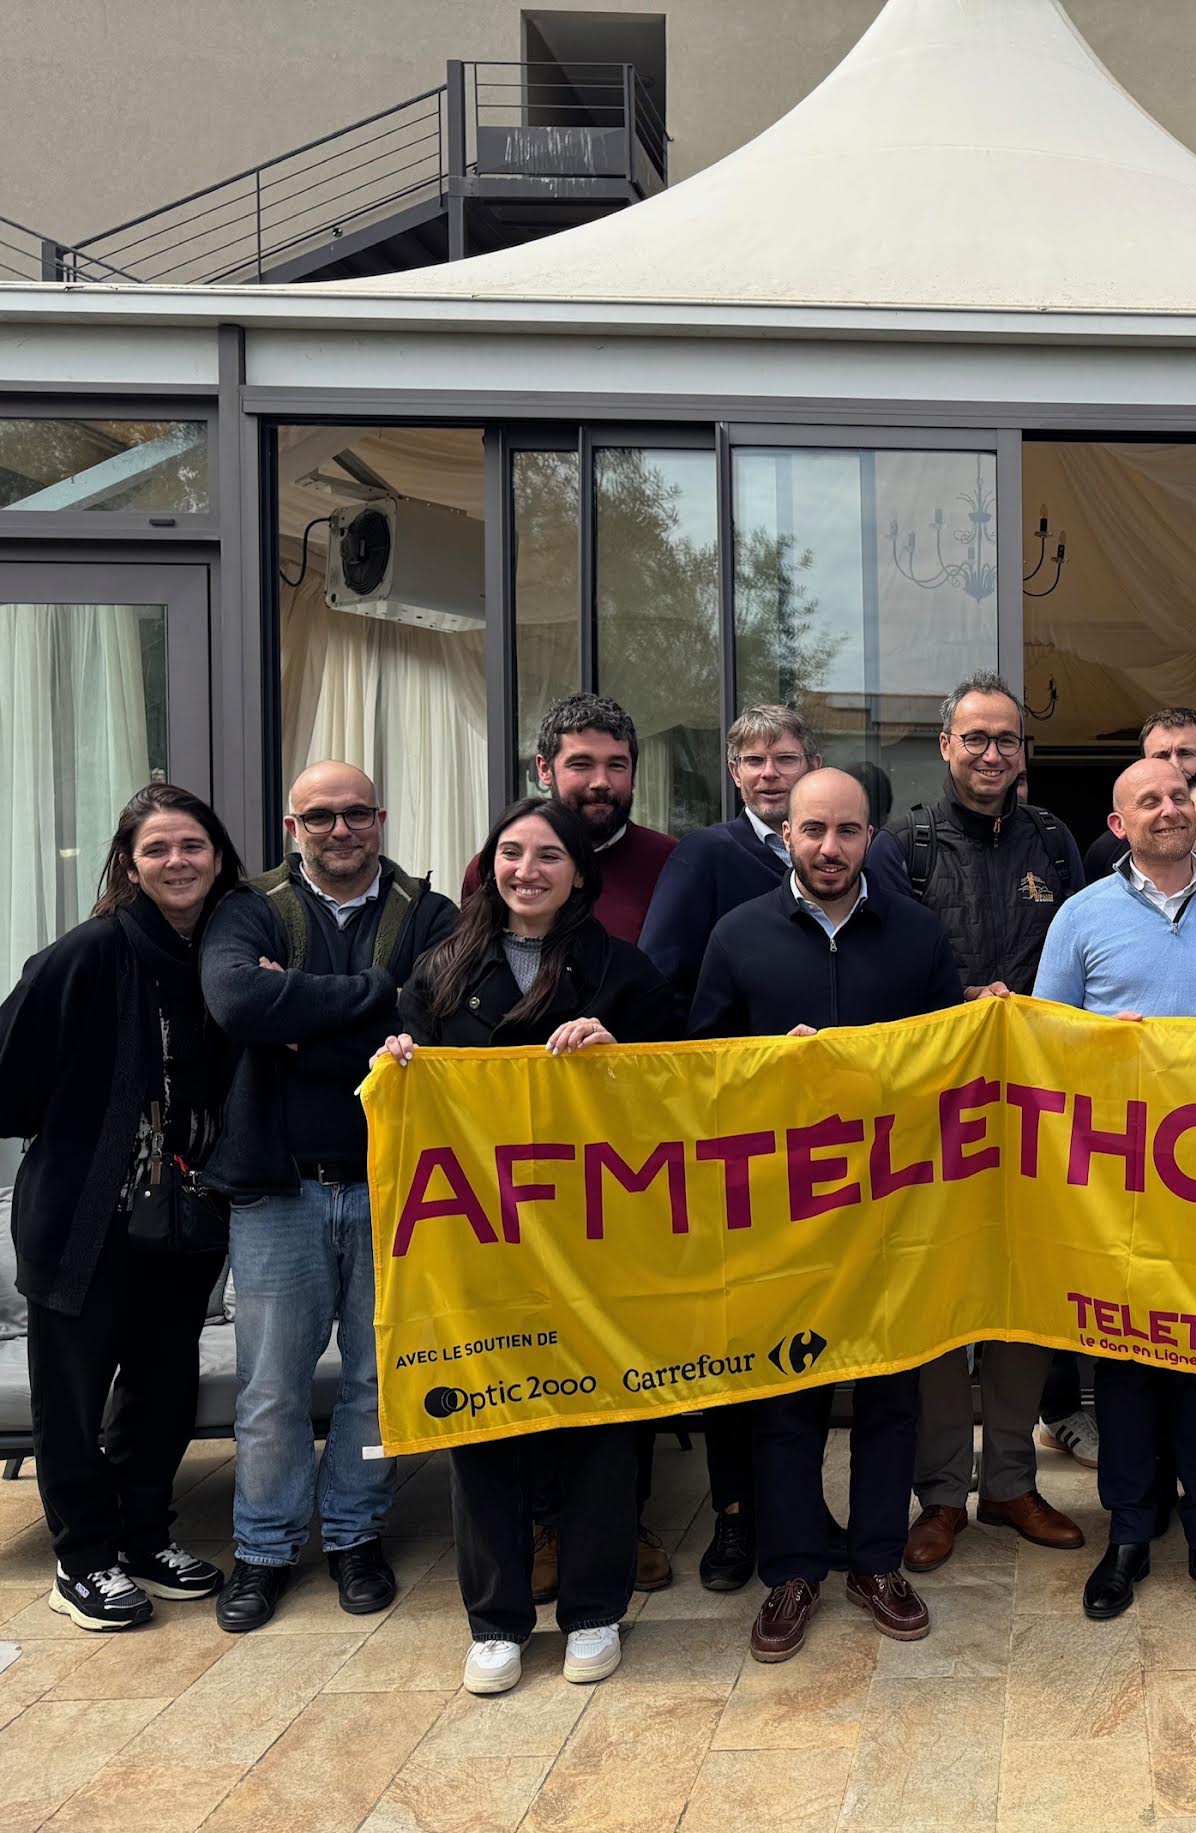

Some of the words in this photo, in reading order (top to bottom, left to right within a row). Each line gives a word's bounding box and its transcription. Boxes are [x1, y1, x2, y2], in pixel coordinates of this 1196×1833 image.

[396, 1350, 438, 1370] AVEC
[443, 1345, 462, 1361] LE
[466, 1334, 533, 1356] SOUTIEN
[537, 1331, 558, 1346] DE
[1099, 1336, 1129, 1353] don
[1132, 1344, 1152, 1358] en
[623, 1353, 756, 1392] Carrefour
[446, 1380, 523, 1417] Optic
[526, 1376, 597, 1400] 2000
